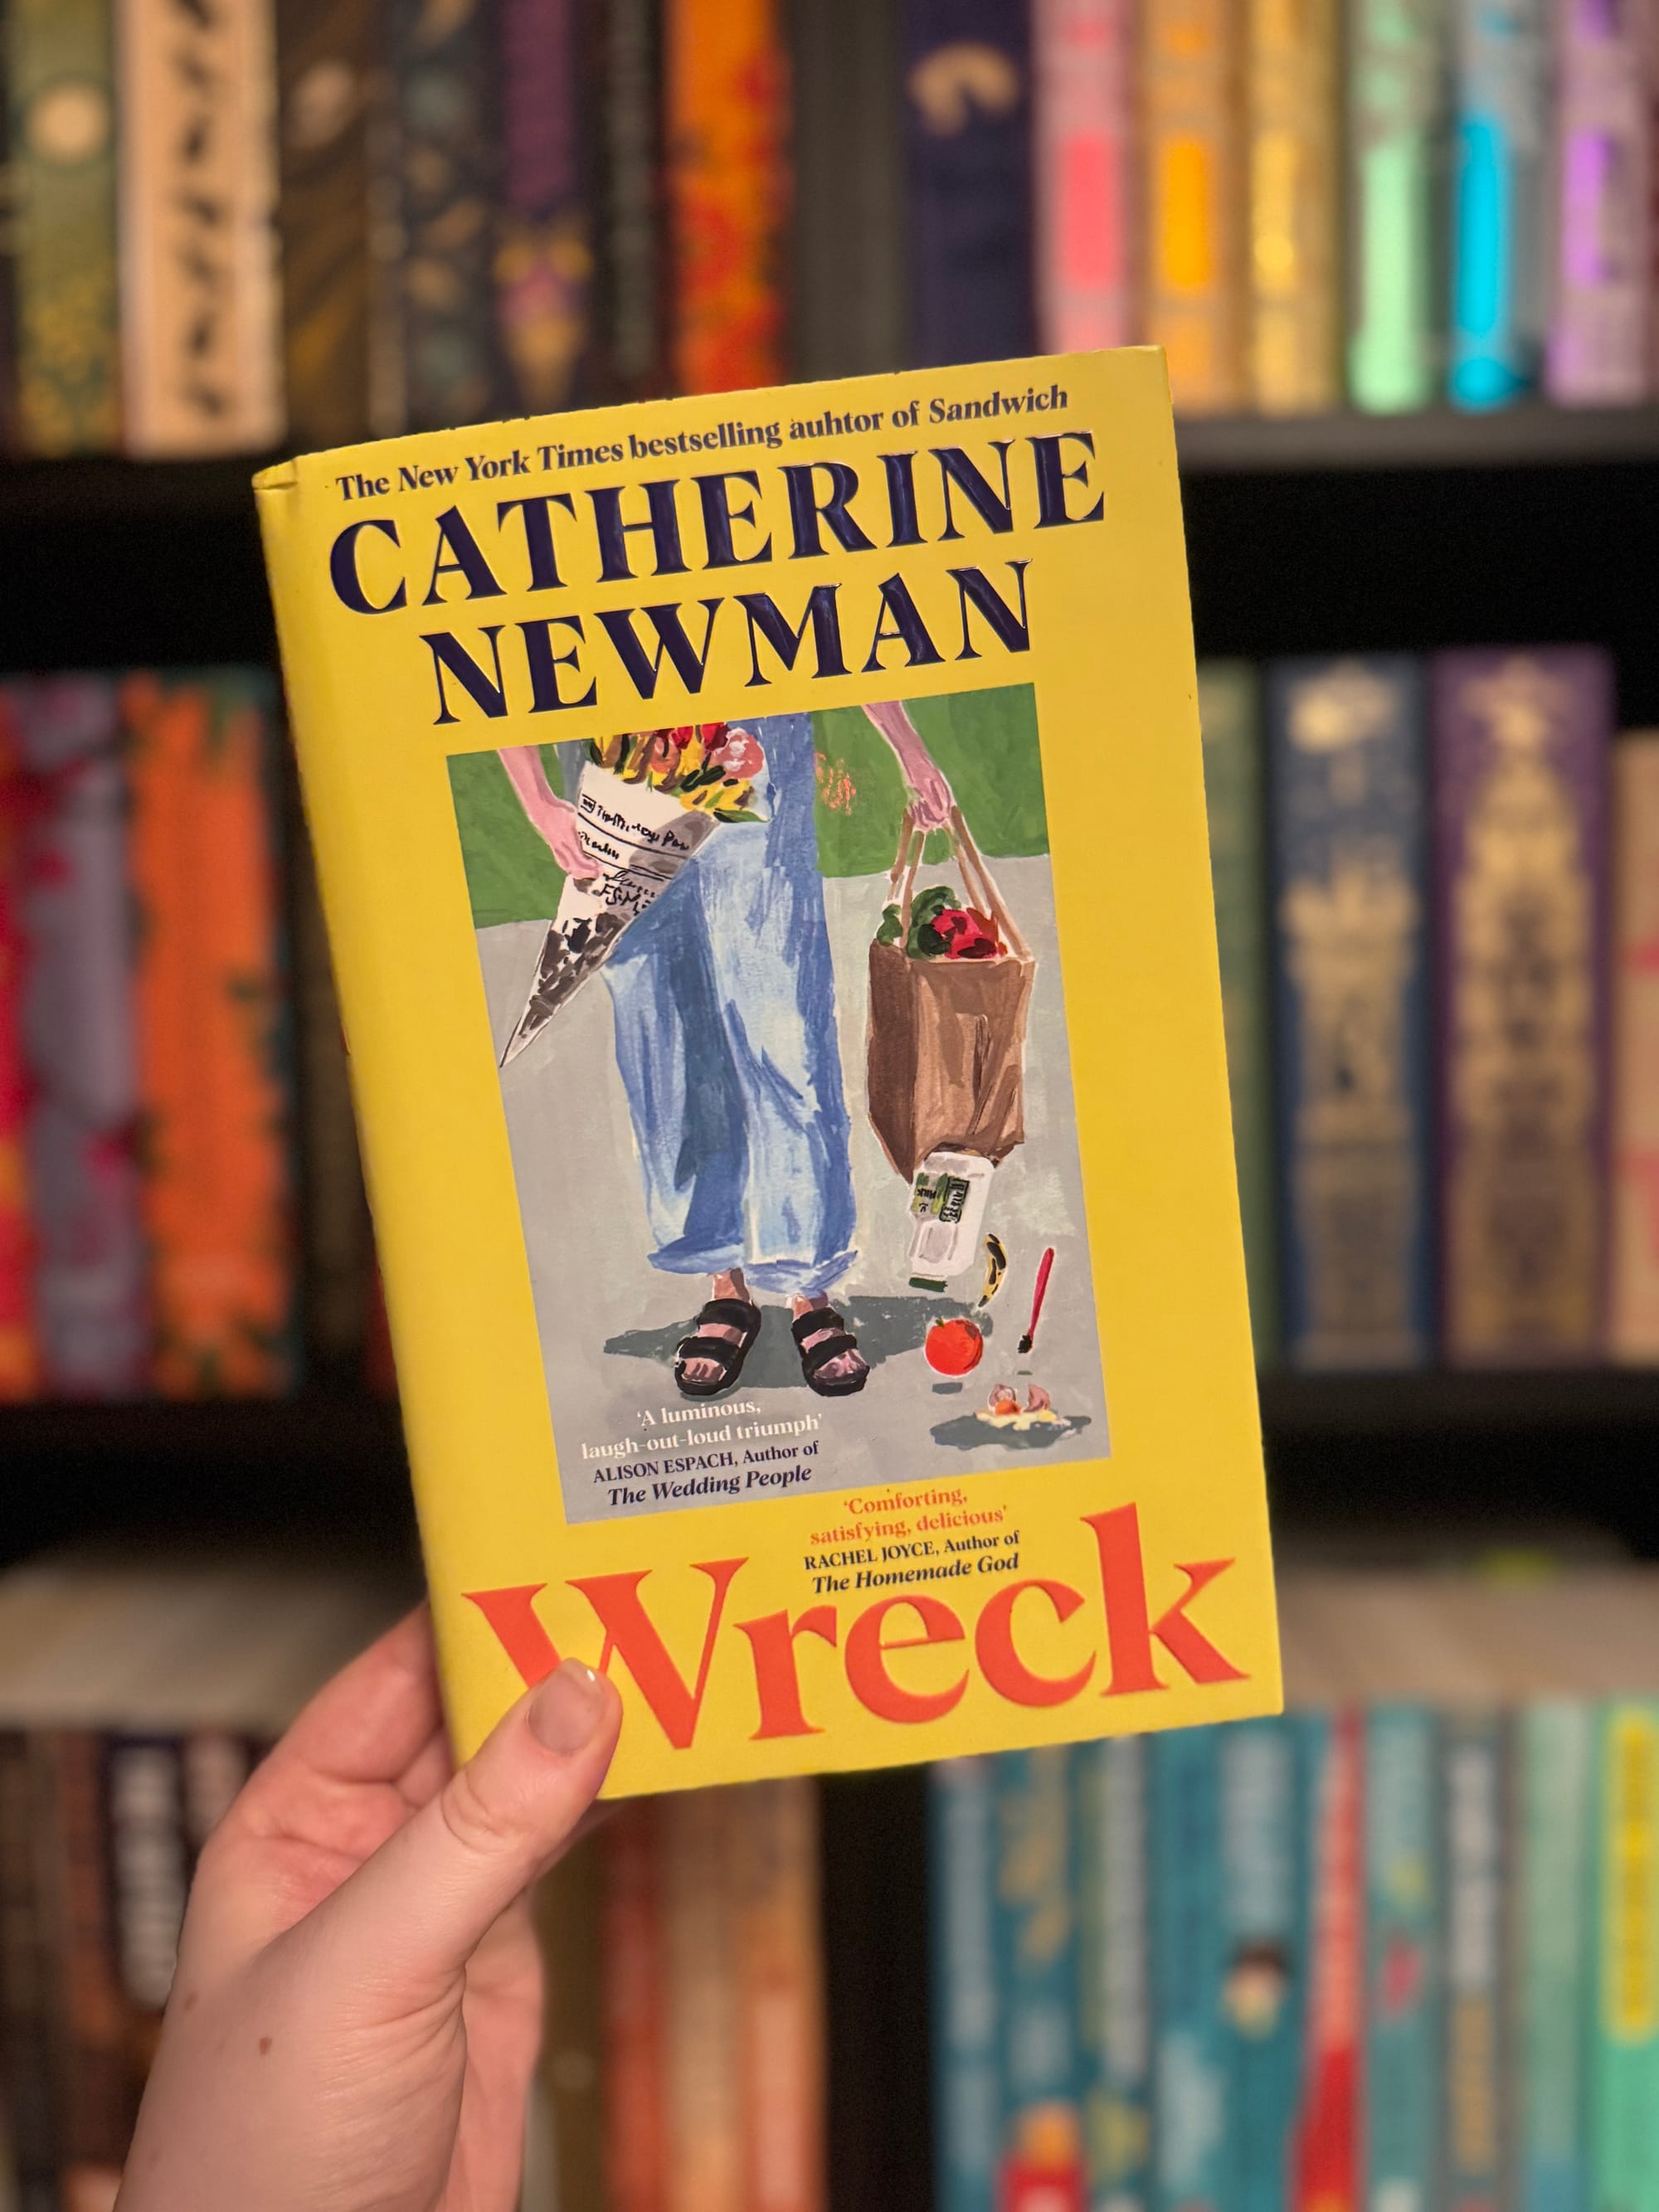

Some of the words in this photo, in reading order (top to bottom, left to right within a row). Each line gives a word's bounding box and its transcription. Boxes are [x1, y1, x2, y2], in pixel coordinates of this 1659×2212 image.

[335, 474, 390, 501] The
[399, 465, 459, 492] New
[465, 450, 531, 481] York
[538, 443, 624, 471] Times
[628, 421, 783, 459] bestselling
[790, 411, 883, 440] auhtor
[892, 400, 920, 427] of
[929, 384, 1068, 424] Sandwich
[328, 430, 1105, 615] CATHERINE
[420, 559, 1035, 725] NEWMAN
[661, 1401, 761, 1423] luminous,
[581, 1425, 732, 1460] laugh-out-loud
[593, 1461, 659, 1483] ALISON
[664, 1451, 738, 1473] ESPACH,
[742, 1445, 798, 1464] Author
[803, 1441, 820, 1456] of
[608, 1487, 646, 1505] The
[652, 1475, 741, 1500] Wedding
[746, 1465, 812, 1488] People
[804, 1548, 878, 1570] RACHEL
[881, 1542, 939, 1563] JOYCE,
[943, 1534, 1000, 1553] Author
[1004, 1530, 1019, 1545] of
[810, 1520, 912, 1545] satisfying,
[812, 1575, 849, 1594] The
[855, 1559, 971, 1588] Homemade
[976, 1553, 1019, 1573] God
[461, 1502, 1252, 1750] Wreck
